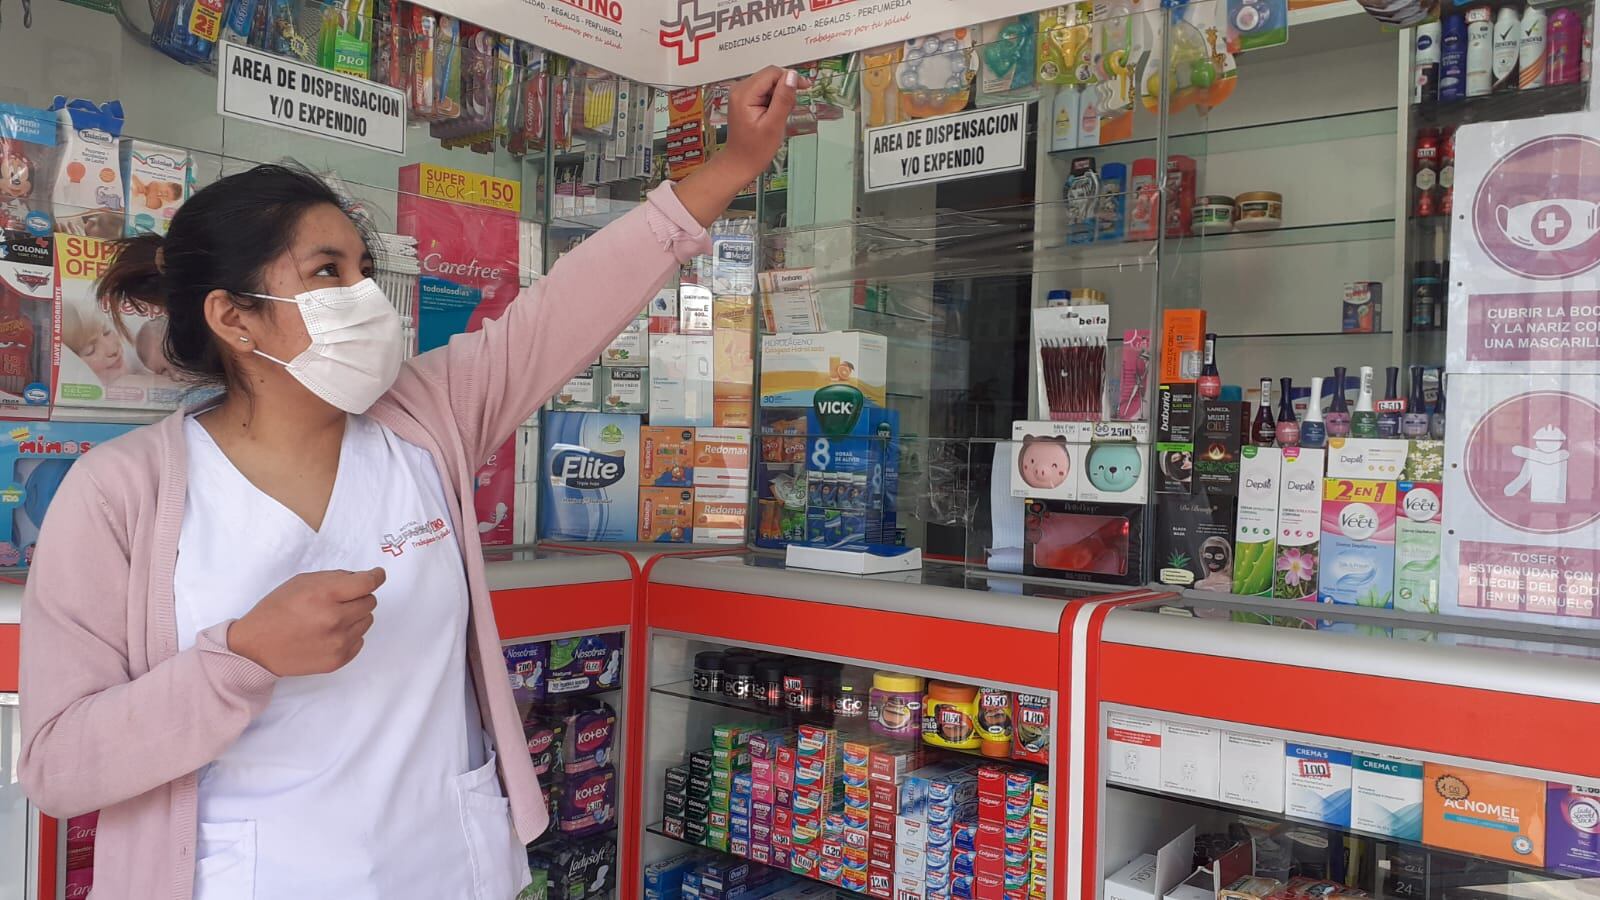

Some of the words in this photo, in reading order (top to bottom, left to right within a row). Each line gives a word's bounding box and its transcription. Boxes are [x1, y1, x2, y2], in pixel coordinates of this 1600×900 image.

[551, 5, 580, 23] REGALOS
[585, 18, 623, 39] PERFUMERIA
[716, 0, 806, 33] FARMA
[718, 36, 760, 52] MEDICINAS
[761, 31, 773, 43] DE
[774, 24, 808, 42] CALIDAD
[814, 12, 851, 30] REGALOS
[857, 0, 912, 21] PERFUMERIA
[336, 55, 365, 66] PRO
[232, 56, 272, 84] AREA
[276, 68, 297, 91] DE
[301, 75, 400, 118] DISPENSACION
[269, 94, 294, 120] Y/O
[298, 103, 368, 137] EXPENDIO
[873, 133, 903, 154] AREA
[907, 130, 922, 149] DE
[926, 113, 1019, 146] DISPENSACION
[901, 156, 920, 177] Y/O
[924, 147, 985, 173] EXPENDIO
[427, 169, 466, 186] SUPER
[427, 181, 466, 200] PACK
[479, 179, 513, 203] 150
[12, 244, 50, 256] COLONIA
[67, 238, 116, 260] SUP
[423, 253, 501, 281] Carefree
[1079, 316, 1107, 326] beifa
[1488, 306, 1542, 321] CUBRIR
[1547, 305, 1564, 318] LA
[1570, 305, 1600, 317] BOC
[1491, 322, 1500, 336] Y
[1505, 321, 1521, 336] LA
[1527, 319, 1570, 334] NARIZ
[1485, 337, 1514, 353] UNA
[1518, 336, 1600, 351] MASCARILL
[763, 395, 775, 404] 30
[818, 401, 851, 414] VICK
[704, 444, 748, 456] Redomax
[812, 437, 832, 470] 8
[562, 455, 618, 480] Elite
[1335, 481, 1364, 500] 2
[1364, 489, 1382, 497] EN
[1384, 483, 1402, 502] 1
[704, 504, 748, 516] Redomax
[1406, 498, 1438, 512] Veet
[1341, 513, 1381, 529] Veet
[1512, 552, 1557, 565] TOSER
[1561, 556, 1570, 566] Y
[1469, 563, 1560, 578] ESTORNUDAR
[1564, 570, 1594, 581] CON
[1469, 576, 1526, 590] PLIEGUE
[1529, 581, 1556, 593] DEL
[1559, 584, 1600, 596] CODO
[1486, 592, 1503, 602] EN
[1507, 593, 1526, 604] UN
[507, 648, 538, 659] Nosotras
[575, 647, 607, 661] Nosotras
[1296, 748, 1321, 757] CREMA
[1362, 760, 1390, 771] CREMA
[978, 769, 1000, 780] Colgate
[978, 796, 1000, 807] Colgate
[1444, 798, 1520, 819] ACNOMEL
[978, 822, 999, 833] Colgate
[978, 848, 999, 859] Colgate
[568, 847, 605, 877] Ladysoft
[977, 876, 998, 886] Colgate
